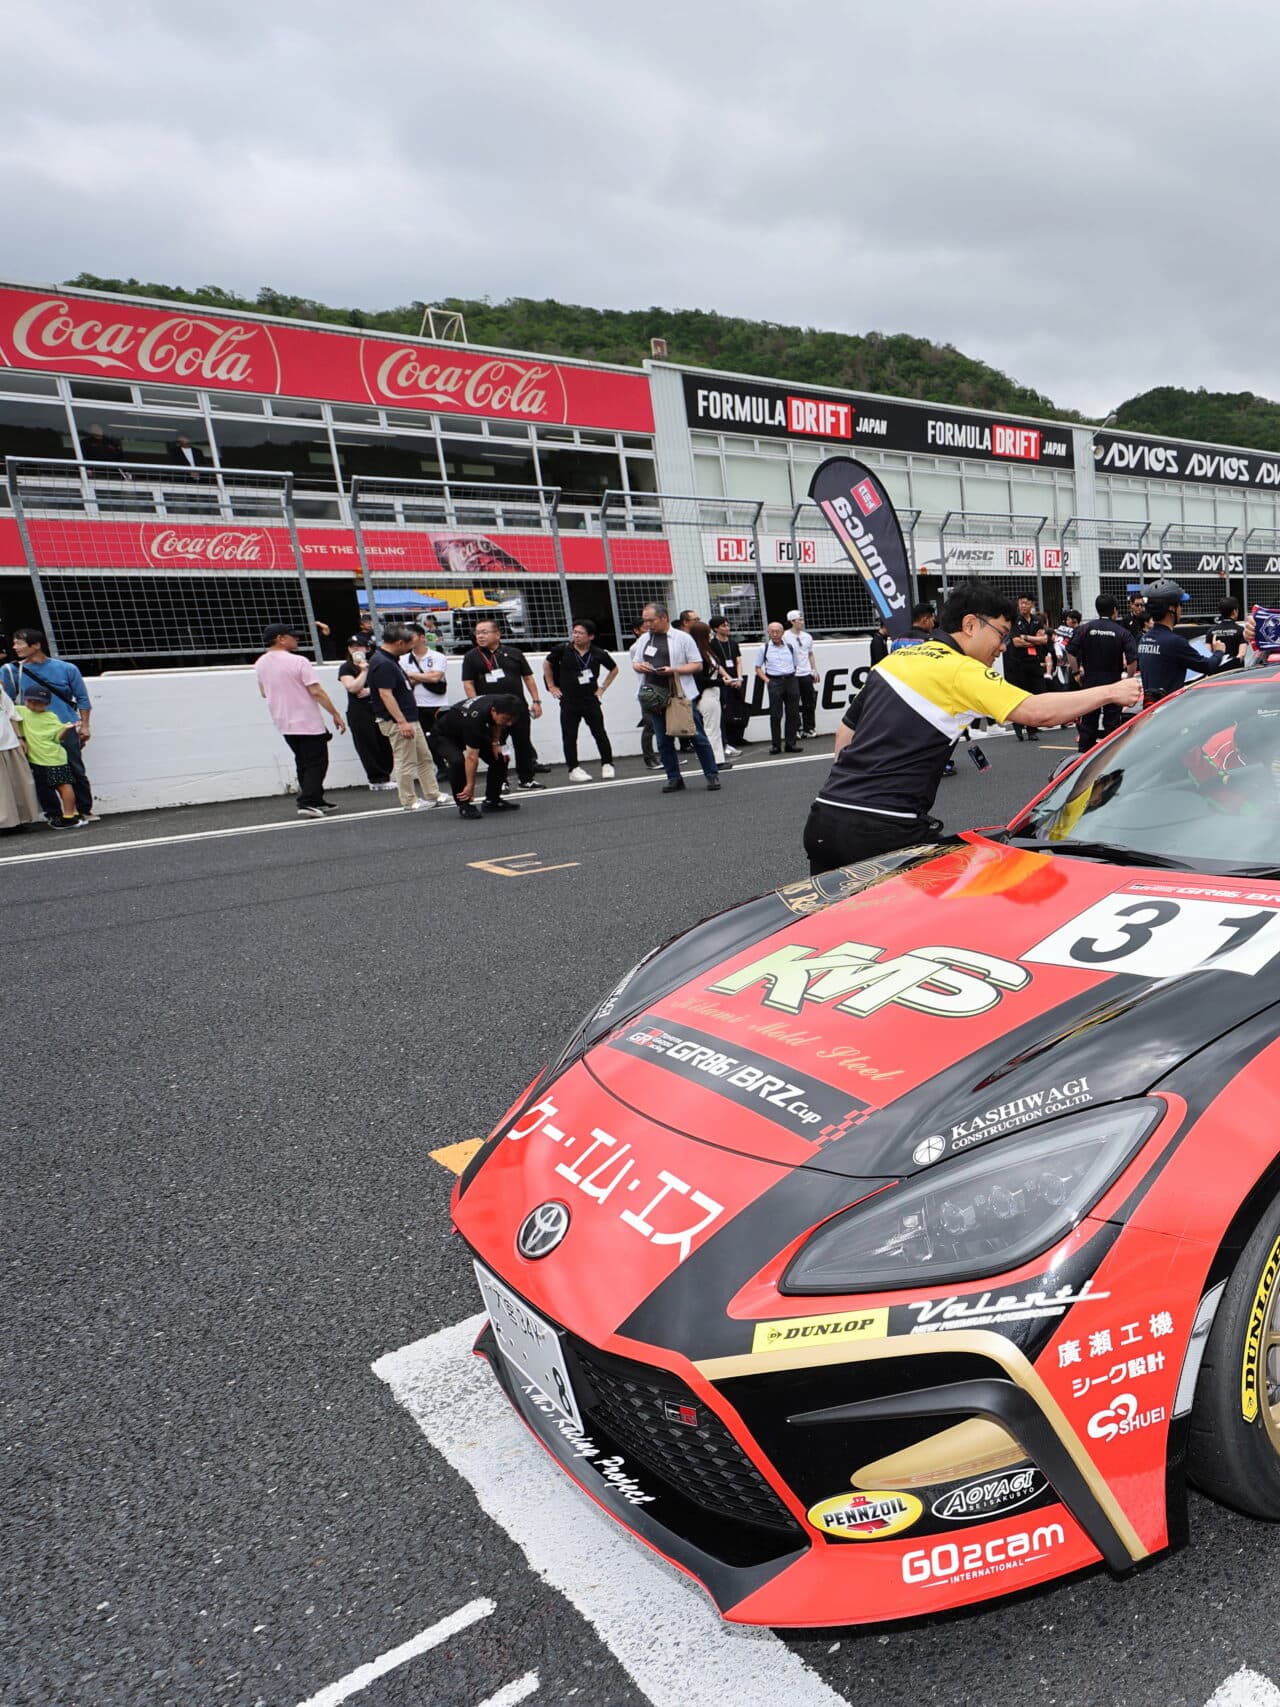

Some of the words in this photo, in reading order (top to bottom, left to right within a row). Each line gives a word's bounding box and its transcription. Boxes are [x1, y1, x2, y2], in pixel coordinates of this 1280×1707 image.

[13, 300, 258, 384] Coca-Cola
[377, 349, 551, 414] Coca-Cola
[698, 389, 785, 426] FORMULA
[790, 399, 850, 436] DRIFT
[856, 416, 888, 436] JAPAN
[928, 419, 992, 451] FORMULA
[995, 428, 1038, 457] DRIFT
[1043, 440, 1067, 457] JAPAN
[151, 529, 262, 562] Coca-Cola
[330, 545, 354, 556] THE
[1069, 900, 1279, 967] 31
[704, 940, 1033, 1019] KMS
[749, 1021, 822, 1047] Mold
[816, 1046, 904, 1081] Steel
[665, 1040, 806, 1108] GR86/BRZ
[787, 1101, 822, 1124] Cup
[951, 1076, 1090, 1140] KASHIWAGI
[951, 1108, 1043, 1150] CONSTRUCTION
[908, 1280, 1112, 1323] Valenti
[783, 1318, 875, 1341] DUNLOP
[1071, 1351, 1166, 1399] シーク設計
[1118, 1406, 1165, 1435] SHUEI
[592, 1455, 656, 1505] Project
[943, 1470, 1035, 1517] AOYAGI
[823, 1497, 908, 1528] PENNZOIL
[902, 1522, 1065, 1585] GO2cam
[949, 1557, 1025, 1585] INTERNATIONAL
